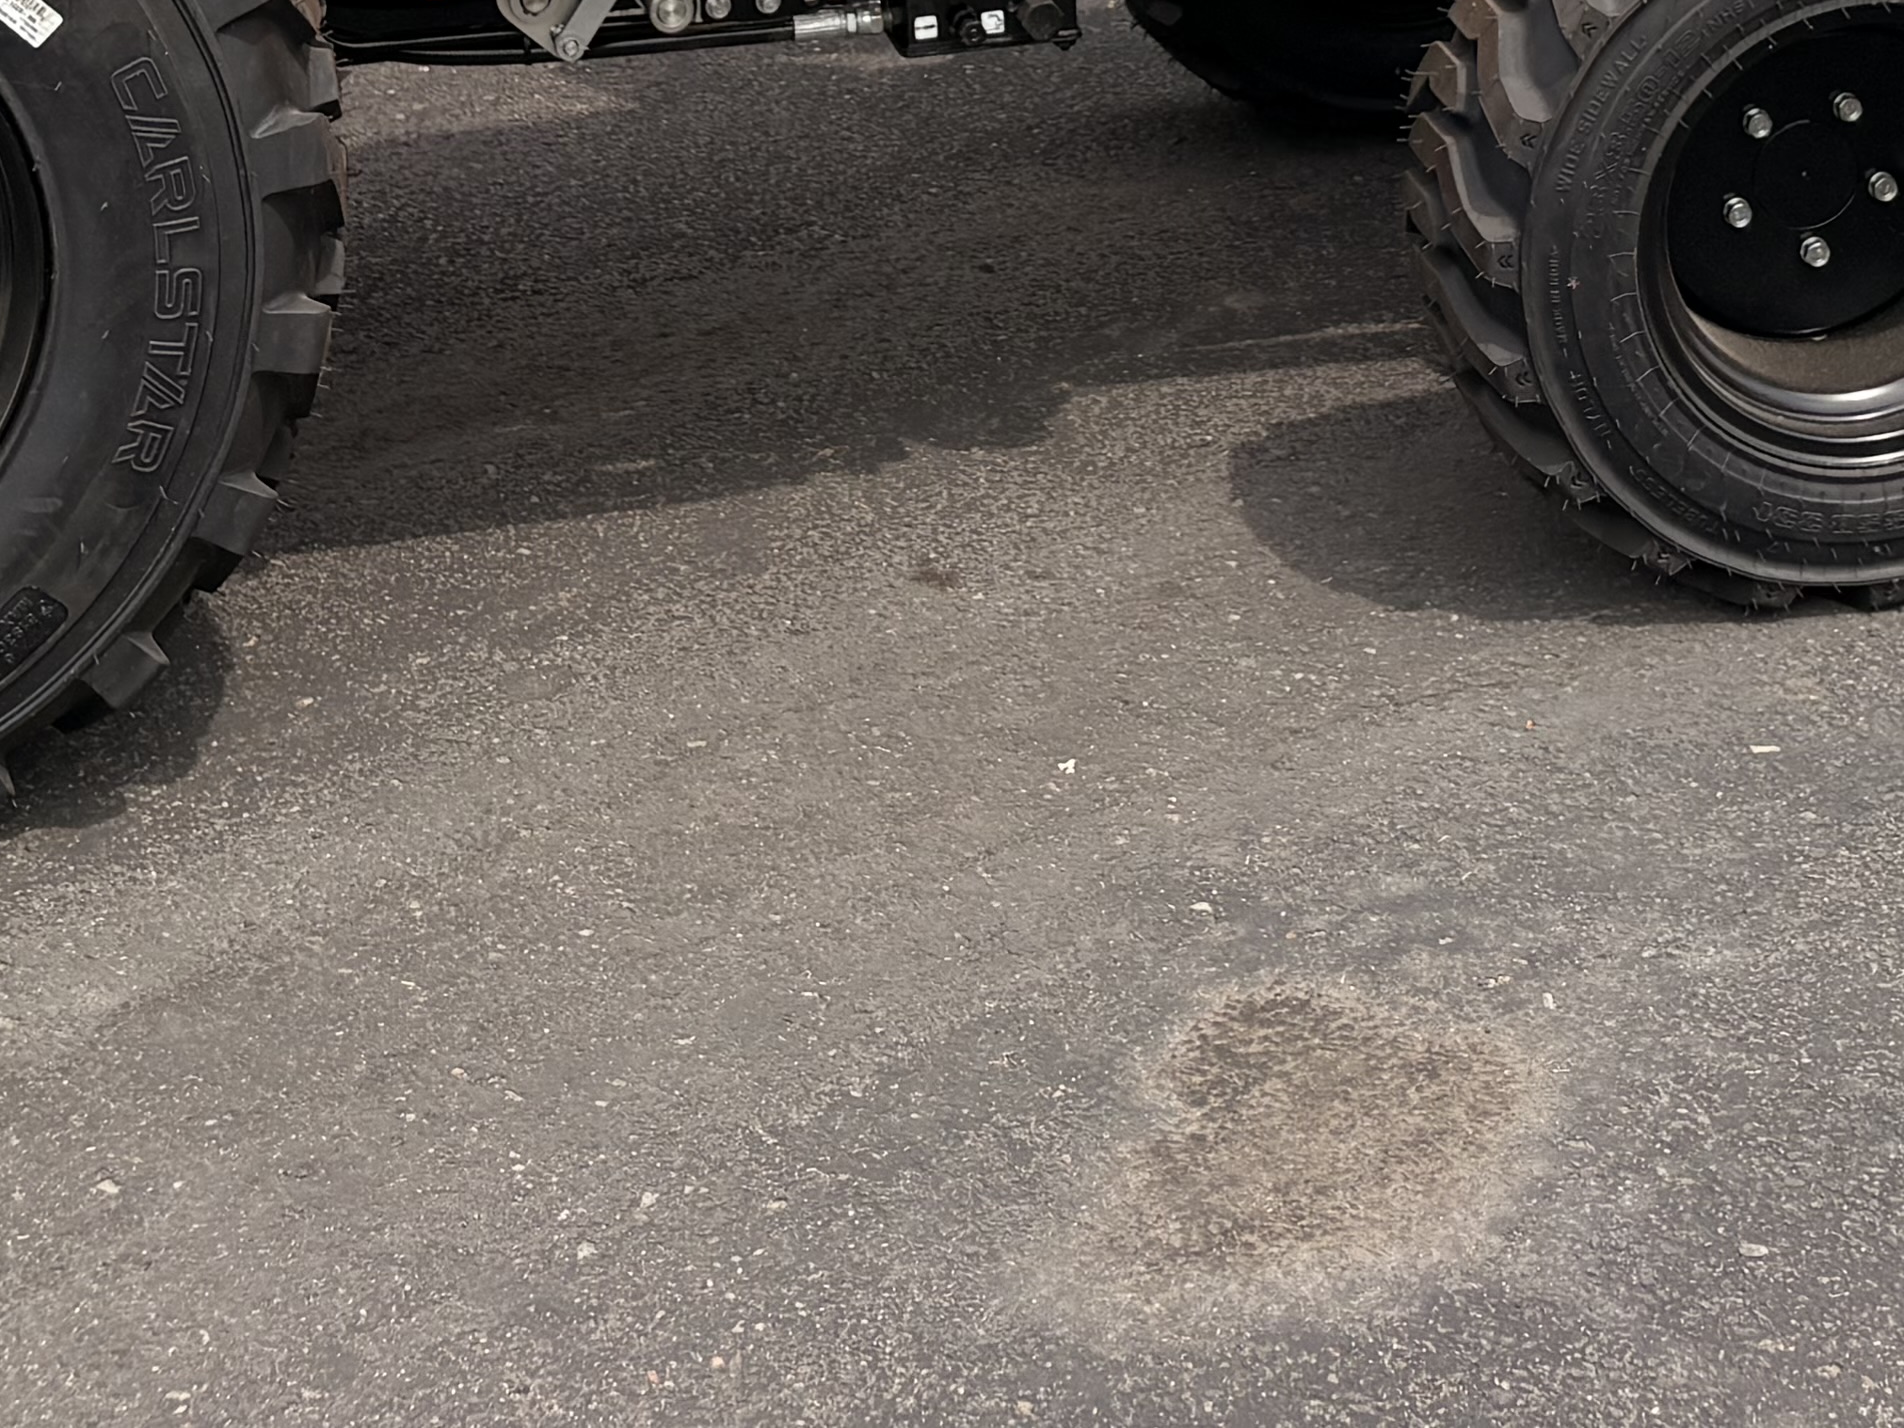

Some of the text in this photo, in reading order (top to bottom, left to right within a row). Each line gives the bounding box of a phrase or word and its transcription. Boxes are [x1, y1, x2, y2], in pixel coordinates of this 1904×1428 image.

[1556, 36, 1647, 192] WIDE SIDEWALL
[110, 57, 203, 472] CARLSTAR
